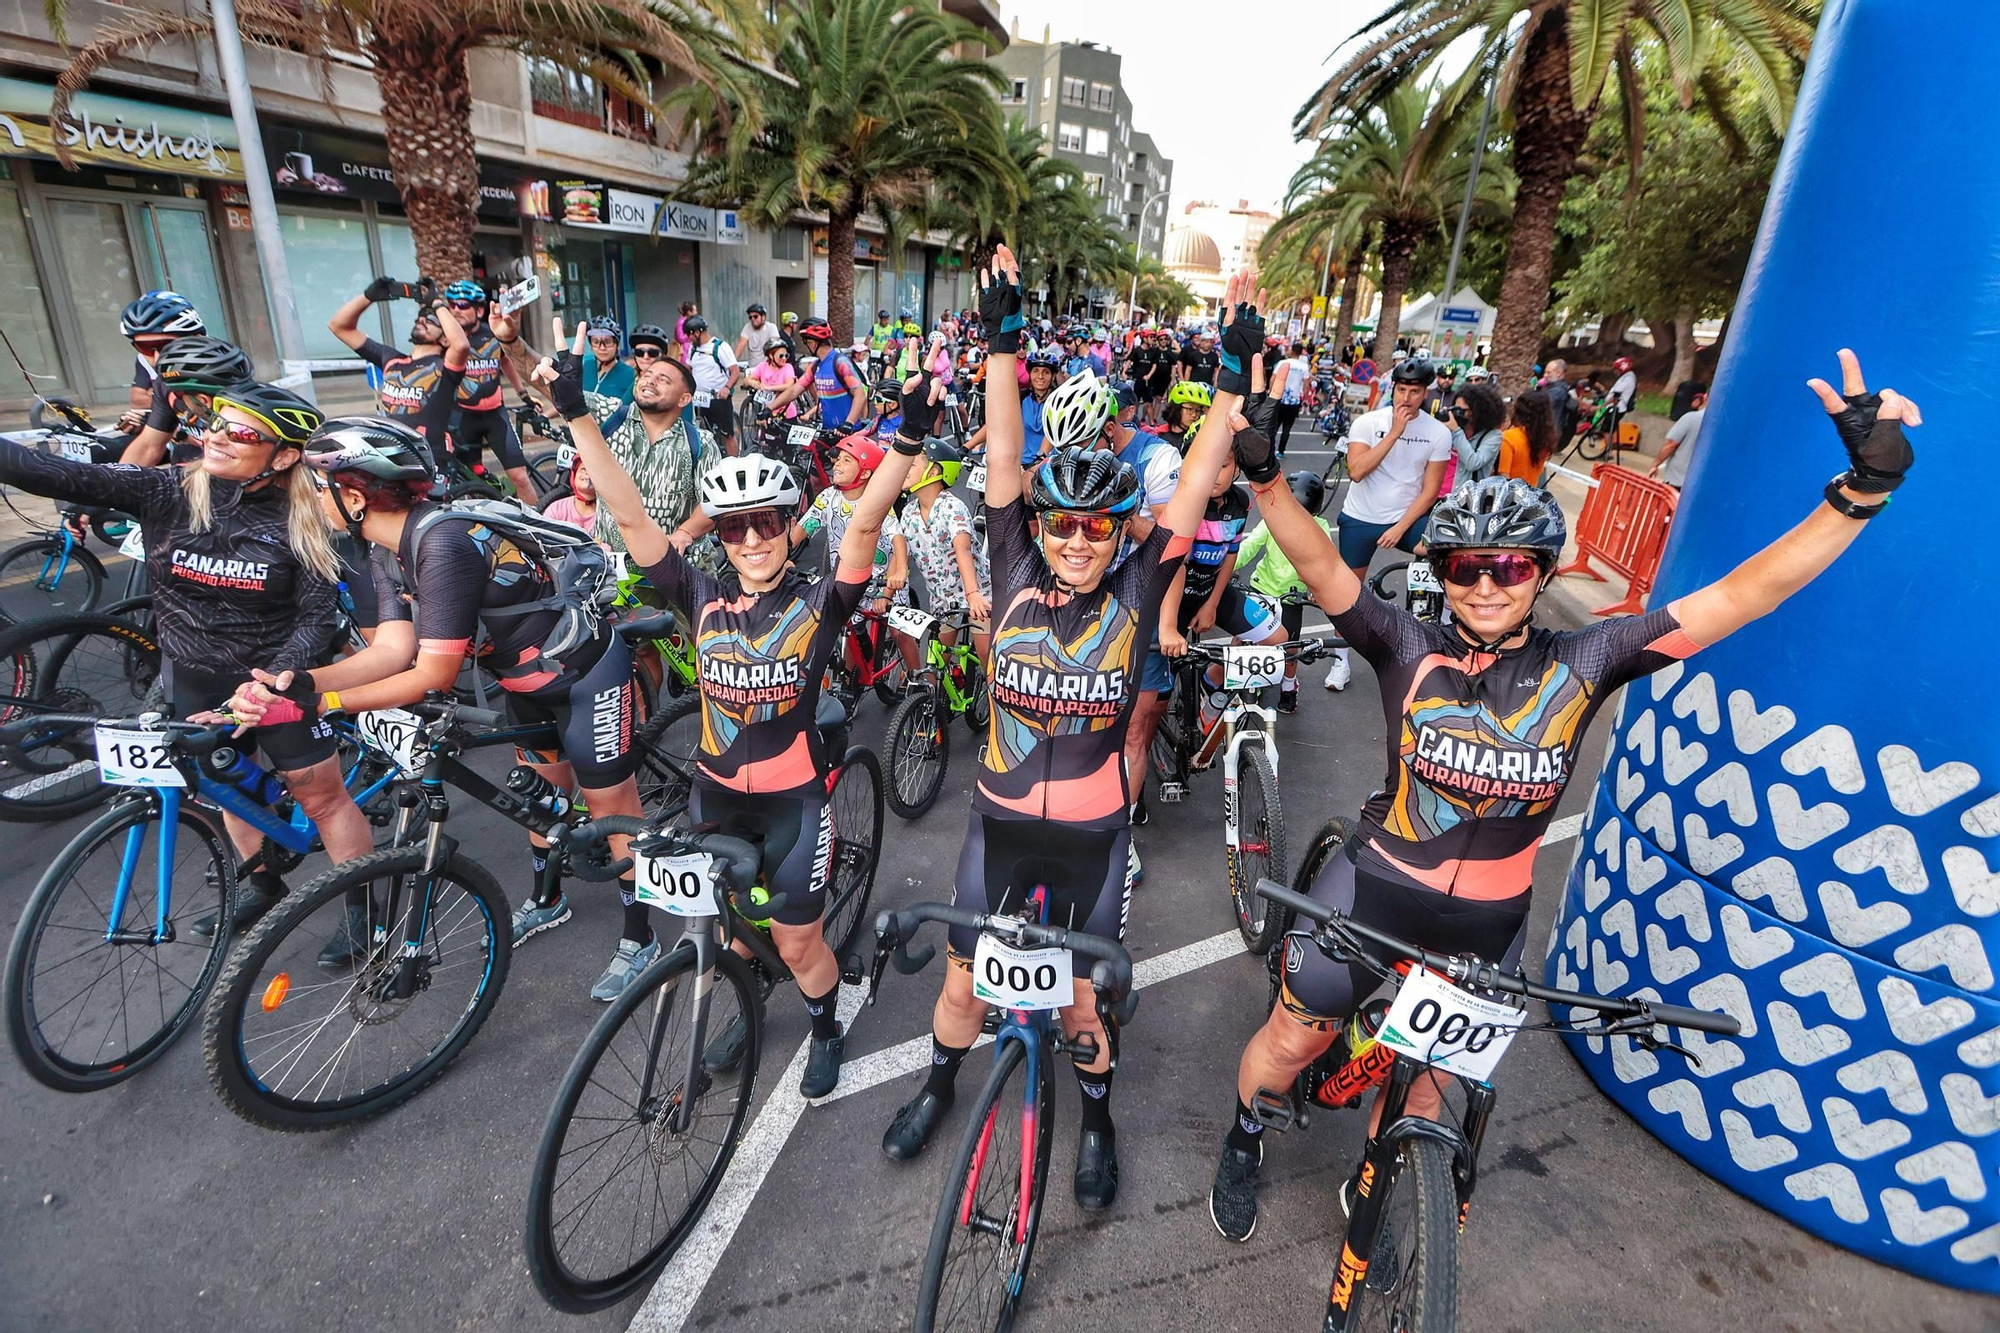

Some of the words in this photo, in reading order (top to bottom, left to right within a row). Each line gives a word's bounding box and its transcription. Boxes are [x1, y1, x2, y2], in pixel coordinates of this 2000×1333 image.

[478, 186, 516, 201] VECERÍA
[67, 440, 86, 455] 103
[791, 430, 811, 439] 216
[562, 449, 577, 462] 07
[973, 472, 986, 484] 19
[172, 549, 269, 580] CANARIAS
[895, 608, 927, 626] 433
[108, 625, 156, 651] MAXXIS
[702, 653, 799, 689] CANARIAS
[995, 654, 1124, 702] CANARIAS
[1234, 655, 1277, 676] 166
[593, 685, 621, 764] CANARIAS
[110, 743, 172, 770] 182
[1416, 725, 1566, 783] CANARIAS
[809, 803, 832, 893] CANARIAS
[648, 857, 701, 899] 000
[985, 956, 1057, 992] 000
[1409, 998, 1497, 1053] 000
